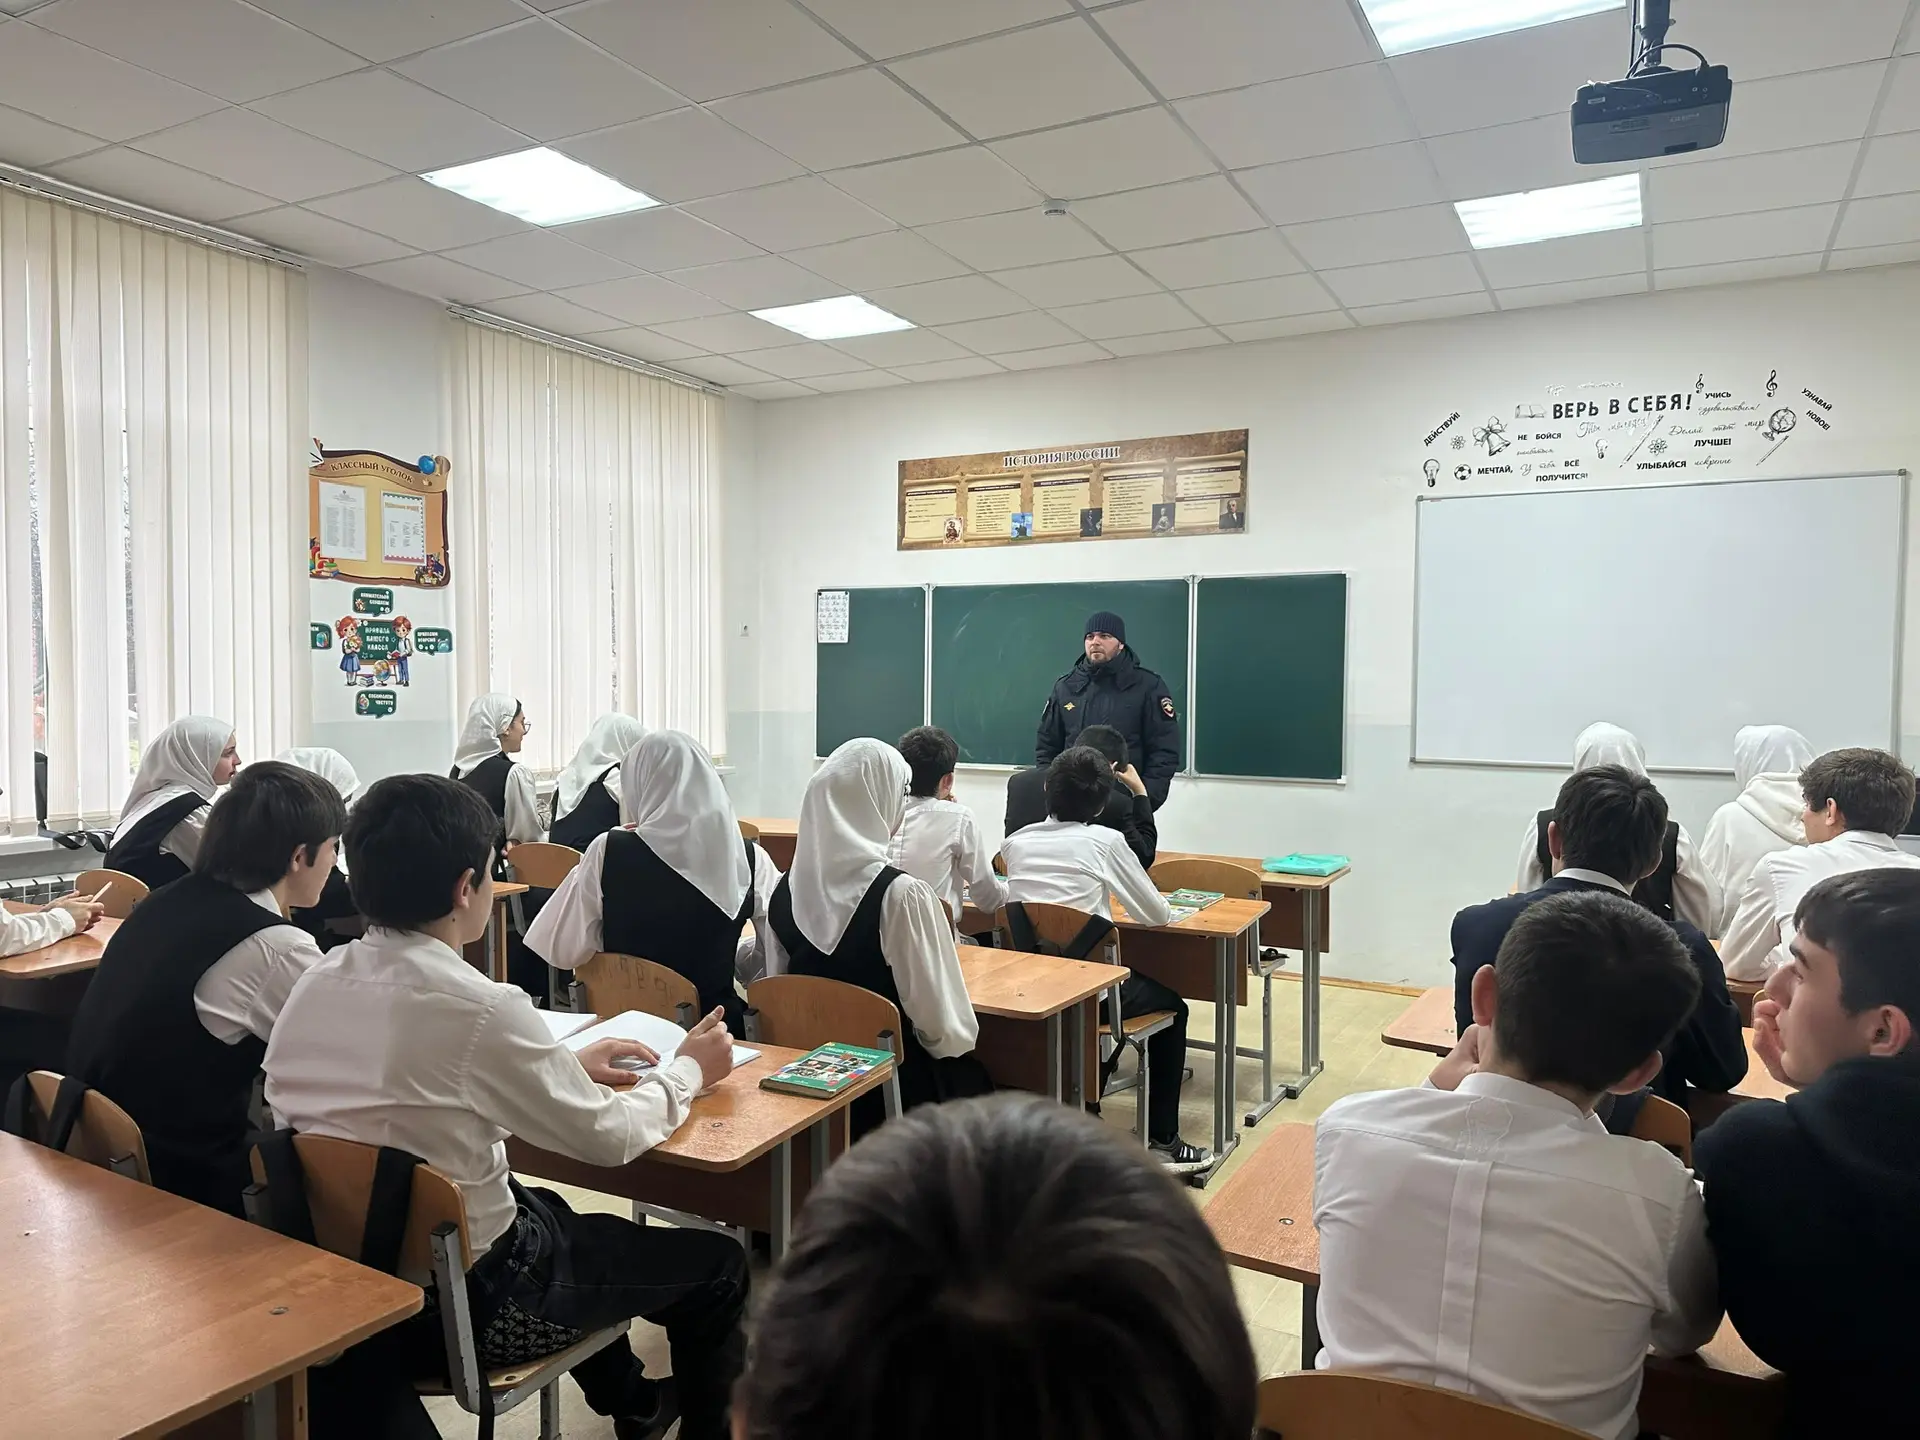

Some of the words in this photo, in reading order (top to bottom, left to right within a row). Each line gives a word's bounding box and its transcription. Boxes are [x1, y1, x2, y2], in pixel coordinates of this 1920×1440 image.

[1705, 391, 1731, 399] УЧИСЬ
[1801, 388, 1833, 411] УЗНАВАЙ
[1553, 401, 1599, 419] ВЕРЬ
[1609, 399, 1620, 415] В
[1628, 393, 1692, 413] СЕБЯ!
[1806, 409, 1831, 431] НОВОЕ!
[1423, 411, 1461, 446] ДЕЙСТВУЙ!
[1535, 432, 1562, 440] БОЙСЯ
[1694, 438, 1732, 447] ЛУЧШЕ!
[1004, 452, 1063, 467] ИСТОРИЯ
[1066, 447, 1120, 462] РОССИИ
[331, 461, 379, 471] КЛАССНЫЙ
[381, 465, 414, 483] УГОЛОК
[1477, 464, 1514, 475] МЕЧТАЙ,
[1636, 460, 1687, 470] УЛЫБАЙСЯ
[1535, 472, 1588, 482] ПОЛУЧИТСЯ!
